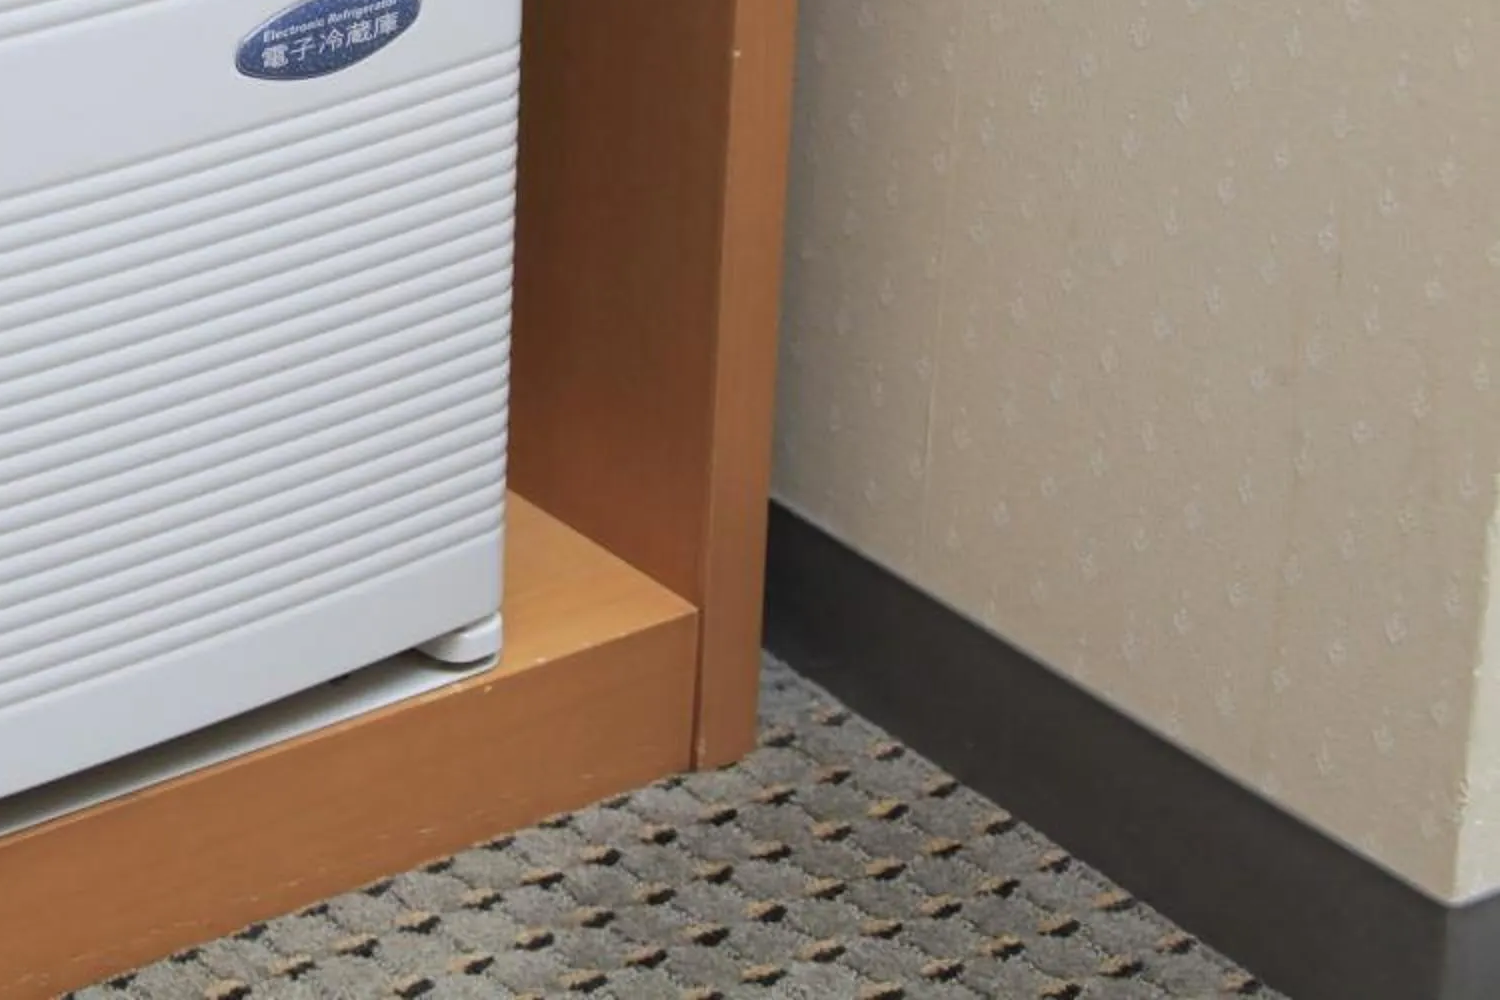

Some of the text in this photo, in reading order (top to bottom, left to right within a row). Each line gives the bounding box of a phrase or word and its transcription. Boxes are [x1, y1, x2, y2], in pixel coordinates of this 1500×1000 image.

[261, 11, 400, 68] 電子冷蔵庫
[263, 18, 325, 43] Electronic
